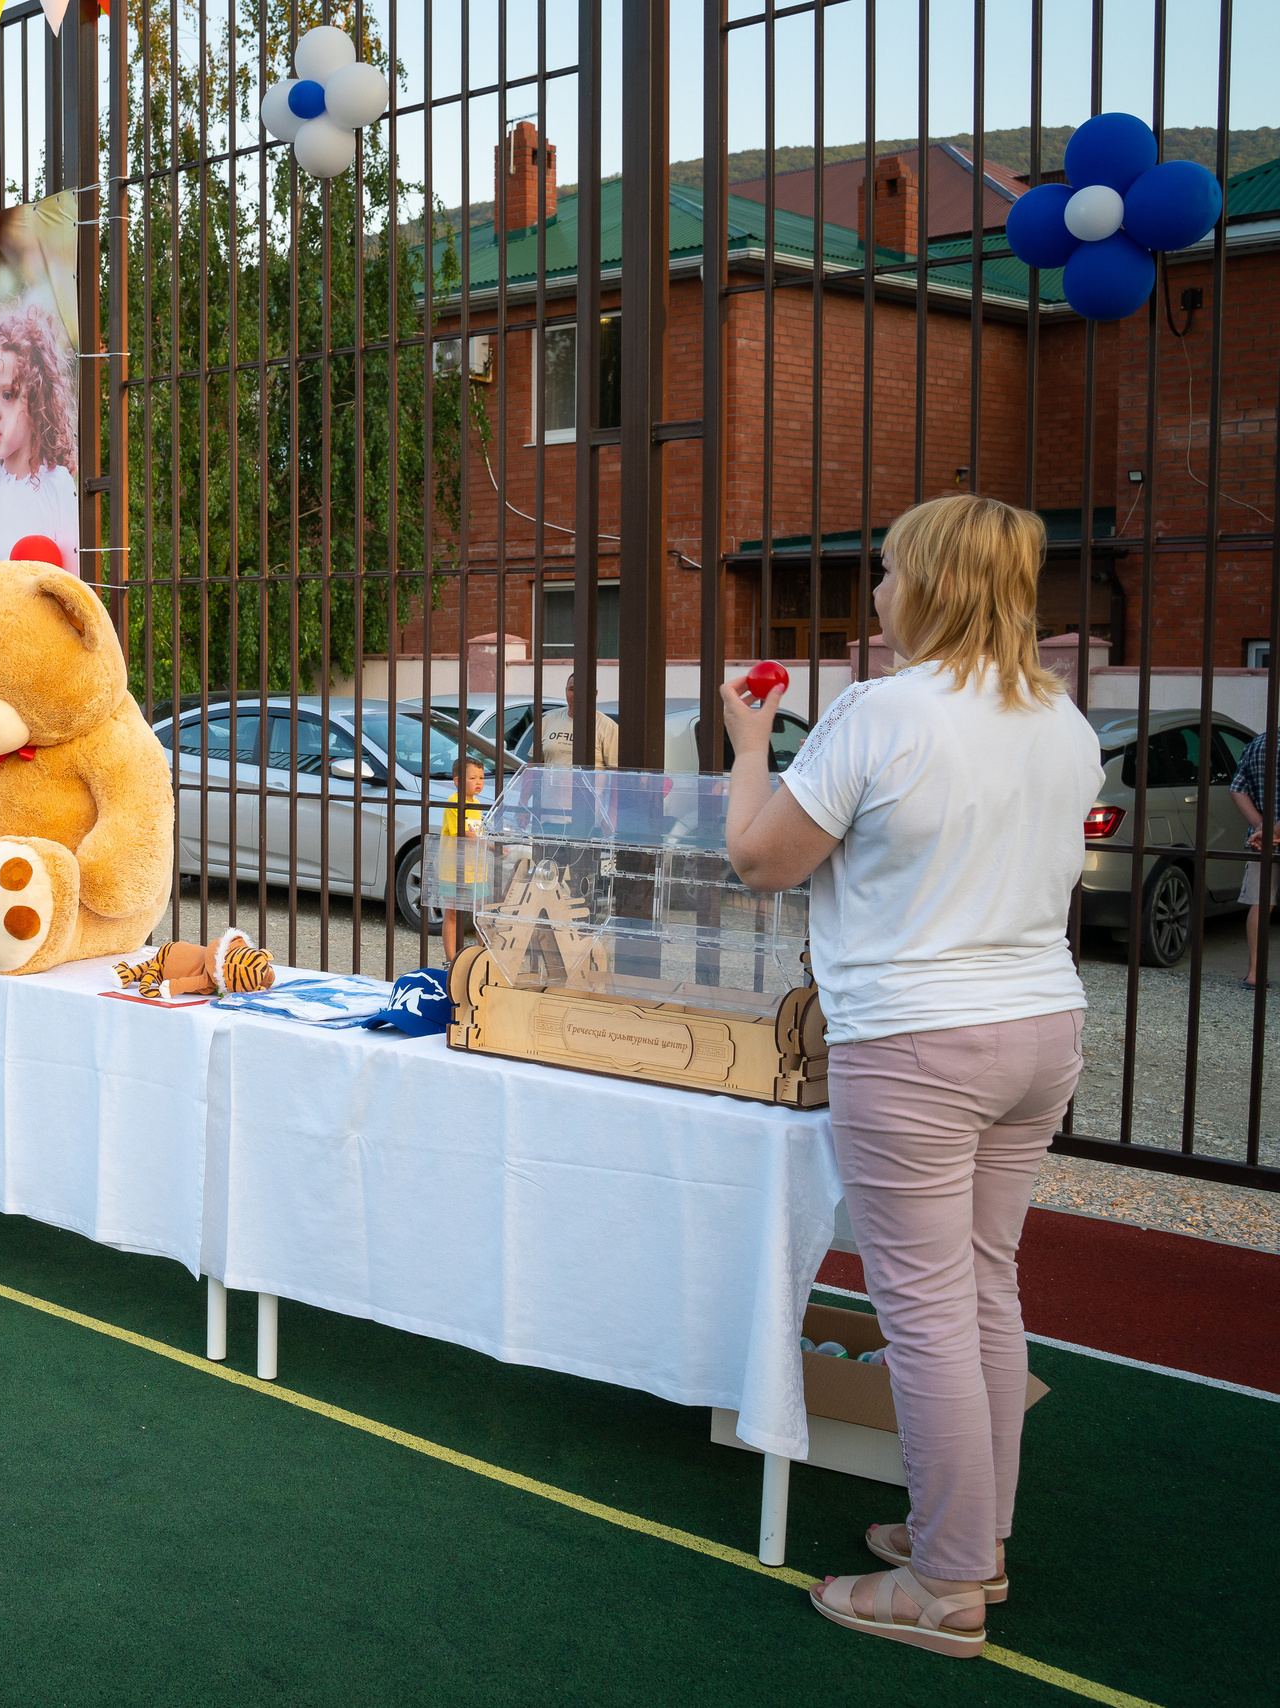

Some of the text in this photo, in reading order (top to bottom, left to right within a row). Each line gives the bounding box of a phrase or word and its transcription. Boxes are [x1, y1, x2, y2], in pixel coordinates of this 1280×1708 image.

[566, 1023, 688, 1053] Греческий культурный центр
